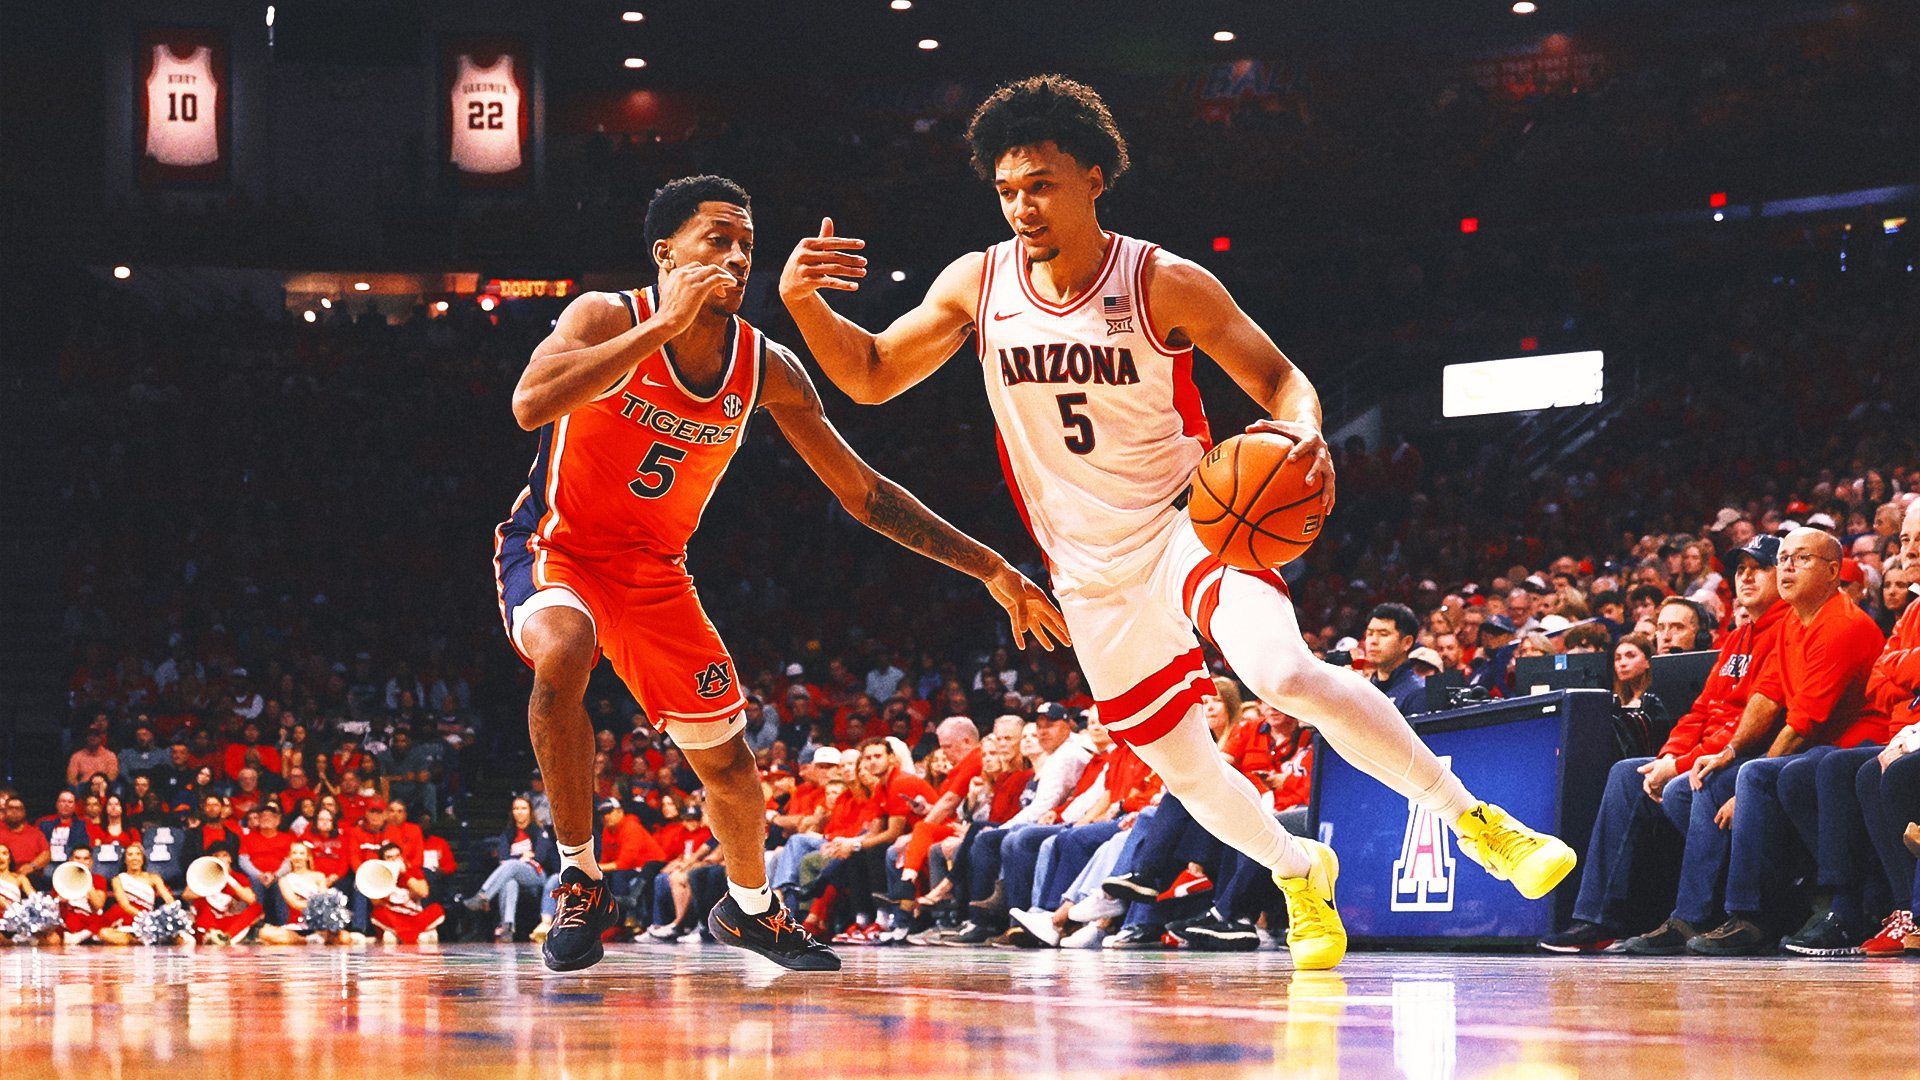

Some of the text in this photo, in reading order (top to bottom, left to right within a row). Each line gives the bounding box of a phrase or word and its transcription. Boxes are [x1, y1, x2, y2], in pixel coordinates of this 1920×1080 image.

[168, 92, 197, 122] 10
[468, 101, 504, 130] 22
[997, 342, 1140, 387] ARIZONA
[620, 390, 740, 445] TIGERS
[722, 393, 743, 418] SEC
[1055, 391, 1096, 455] 5
[627, 440, 689, 500] 5
[1391, 756, 1457, 912] A
